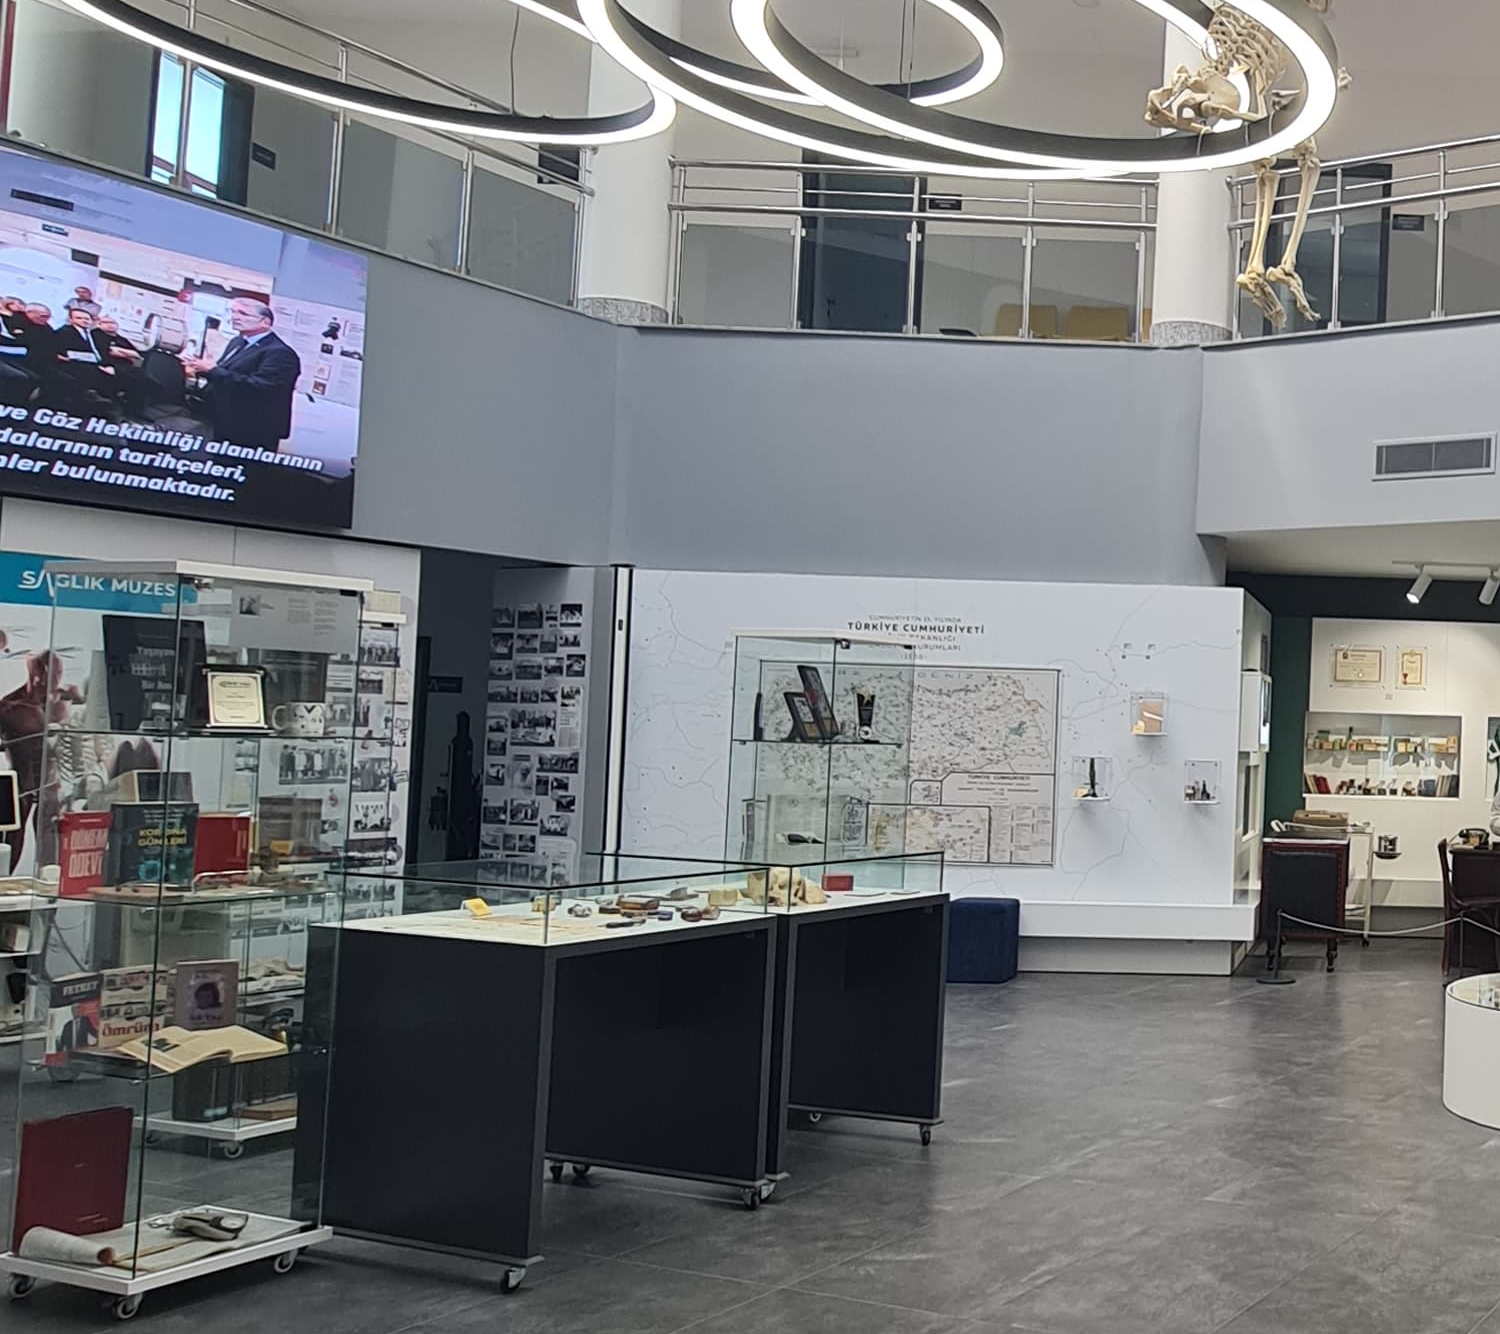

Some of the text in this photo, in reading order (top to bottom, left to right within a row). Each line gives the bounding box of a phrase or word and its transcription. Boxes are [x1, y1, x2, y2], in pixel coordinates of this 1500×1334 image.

[0, 404, 325, 472] ve Göz Hekimliği alanlarının
[50, 460, 236, 501] bulunmaktadır.
[118, 446, 248, 483] tarihçeleri,
[848, 621, 985, 634] TÜRKİYE CUMHURİYETİ
